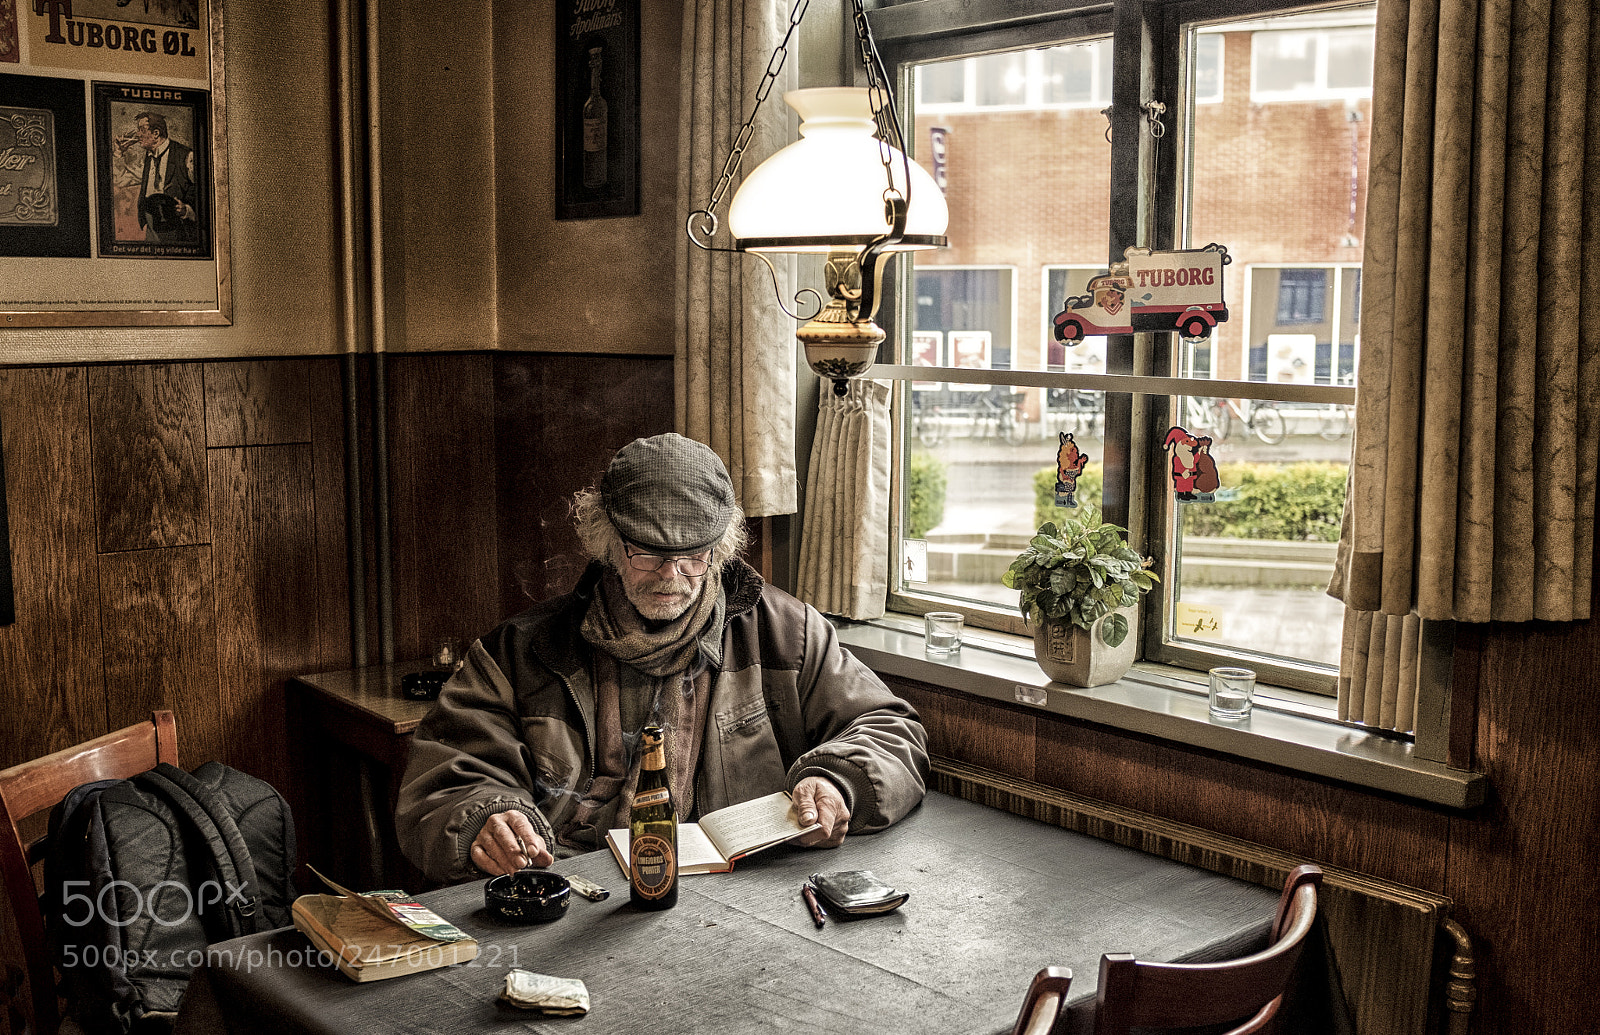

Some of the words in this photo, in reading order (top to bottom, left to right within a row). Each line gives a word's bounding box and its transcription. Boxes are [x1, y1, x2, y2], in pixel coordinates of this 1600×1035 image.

[36, 0, 158, 54] TUBORG
[163, 30, 196, 57] ØL
[121, 87, 182, 100] TUBORG
[1136, 267, 1215, 288] TUBORG
